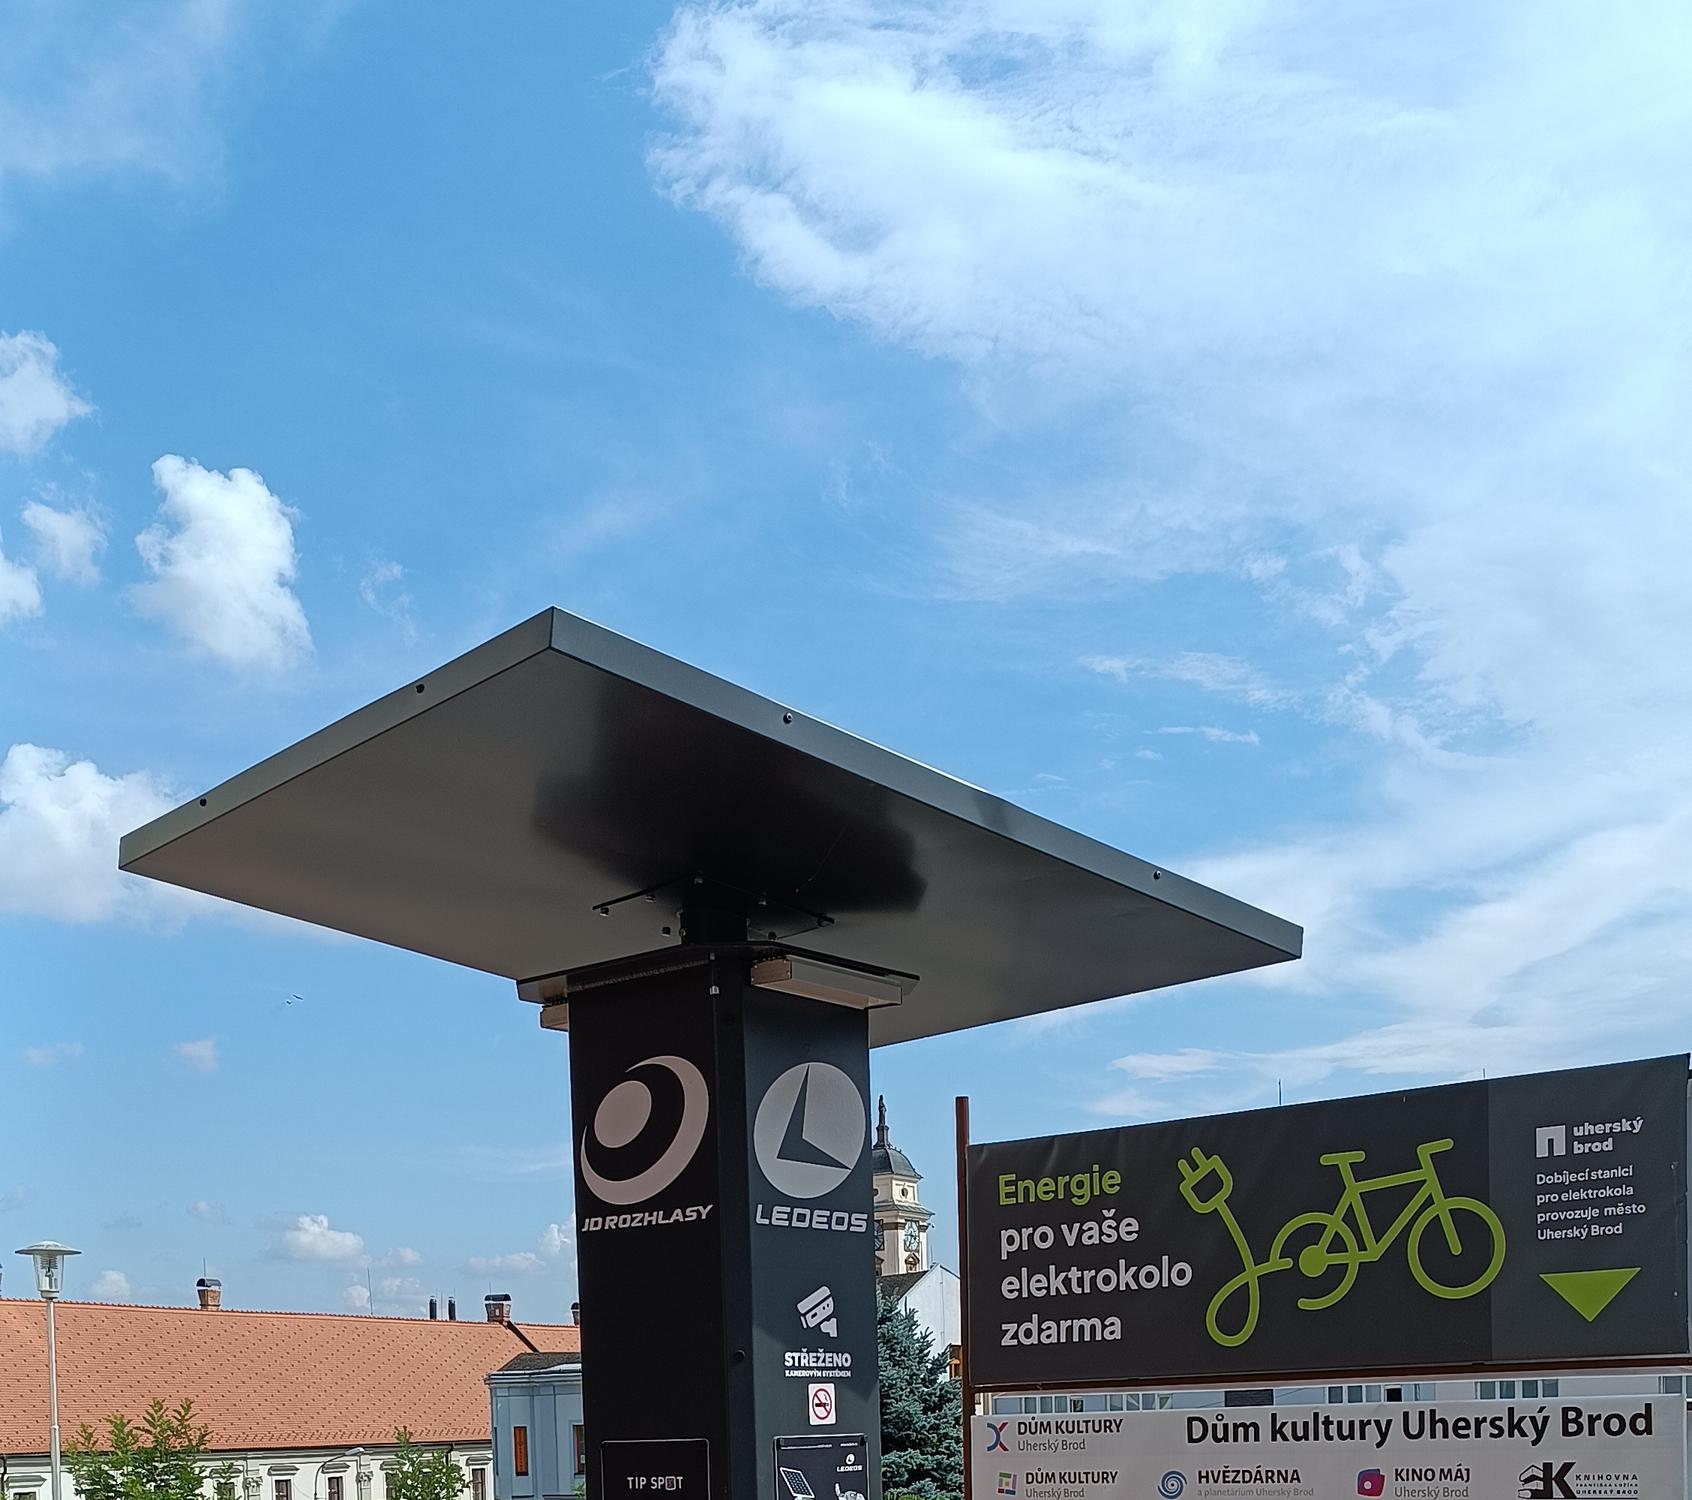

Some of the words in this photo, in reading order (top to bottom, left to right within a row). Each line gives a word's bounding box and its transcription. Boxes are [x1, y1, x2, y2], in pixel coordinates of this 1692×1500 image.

[1573, 1116, 1643, 1136] uherský
[1573, 1137, 1613, 1154] brod
[999, 1164, 1121, 1206] Energie
[1536, 1168, 1589, 1185] Dobíjecí
[1590, 1165, 1633, 1180] stanici
[1536, 1192, 1559, 1206] pro
[1560, 1184, 1634, 1201] elektrokola
[604, 1204, 714, 1230] ROZHLASY
[755, 1204, 868, 1232] LEDEOS
[1537, 1206, 1600, 1224] provozuje
[1603, 1203, 1646, 1216] město
[1001, 1226, 1055, 1260] pro
[1060, 1208, 1140, 1247] vaše
[1537, 1224, 1589, 1240] Uherský
[1591, 1222, 1623, 1236] Brod
[1001, 1255, 1193, 1300] elektrokolo
[1001, 1313, 1122, 1346] zdarma
[784, 1347, 852, 1367] STŘEŽENO
[1017, 1416, 1052, 1436] DŮM
[1055, 1418, 1123, 1435] KULTURY
[1186, 1414, 1261, 1444] Dům
[1270, 1411, 1393, 1449] kultury
[1402, 1405, 1550, 1447] Uherský
[1560, 1403, 1654, 1438] Brod
[1017, 1438, 1060, 1453] Uherský
[1061, 1438, 1086, 1450] Brod
[627, 1476, 646, 1490] TIP
[1025, 1467, 1056, 1485] DŮM
[1059, 1471, 1118, 1485] KULTURY
[1197, 1465, 1302, 1484] HVĚZDÁRNA
[1394, 1468, 1436, 1482] KINO
[1439, 1463, 1471, 1483] MÁJ
[1025, 1488, 1061, 1500] Uherský
[1063, 1488, 1085, 1498] Brod
[1204, 1488, 1254, 1498] planetárium
[1293, 1488, 1314, 1496] Brod
[1394, 1486, 1439, 1500] Uherský
[1442, 1487, 1469, 1498] Brod
